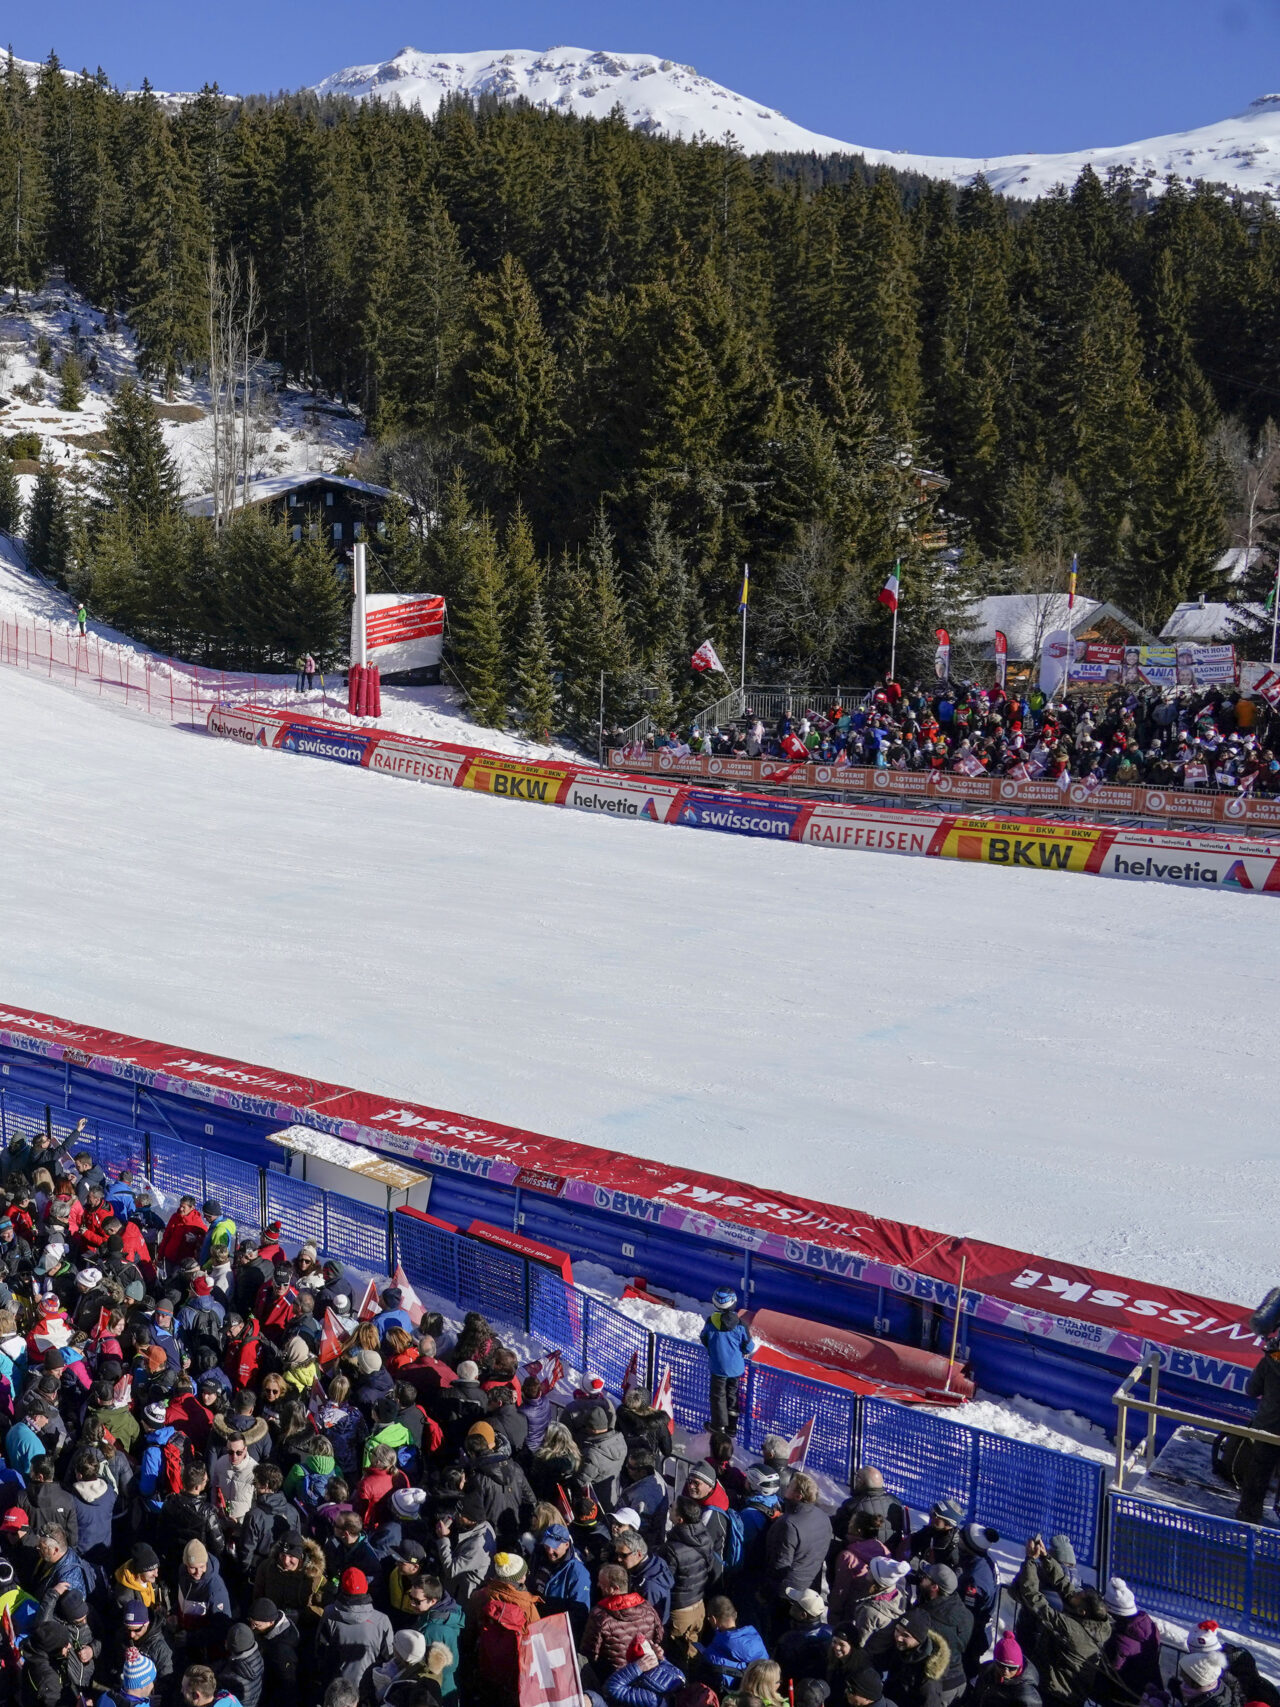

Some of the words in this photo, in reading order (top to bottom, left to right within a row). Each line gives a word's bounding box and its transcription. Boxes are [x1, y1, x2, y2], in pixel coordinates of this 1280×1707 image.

[1088, 645, 1122, 655] MICHELLE
[1080, 664, 1103, 672] ILKA
[1147, 667, 1174, 678] ANIA
[1194, 666, 1232, 674] RAGNHILD
[211, 720, 254, 741] helvetia
[298, 739, 362, 761] swisscom
[373, 753, 454, 782] RAIFFEISEN
[836, 771, 865, 779] LOTERIE
[895, 775, 927, 784] LOTERIE
[830, 777, 865, 785] ROMANDE
[889, 782, 926, 790] ROMANDE
[958, 780, 991, 788] LOTERIE
[493, 774, 549, 801] BKW
[951, 787, 991, 796] ROMANDE
[1017, 792, 1060, 800] ROMANDE
[1095, 790, 1132, 799] LOTERIE
[574, 790, 638, 815] helvetia
[1087, 797, 1132, 806] ROMANDE
[1174, 798, 1212, 806] LOTERIE
[1165, 804, 1212, 814] ROMANDE
[1256, 805, 1280, 813] LOTE
[1246, 812, 1280, 821] ROMAN
[701, 809, 790, 835] swisscom
[969, 821, 988, 829] BKW
[1001, 823, 1021, 831] BKW
[1035, 826, 1056, 835] BKW
[1071, 829, 1092, 838] BKW
[810, 823, 924, 852] RAIFFEISEN
[988, 838, 1073, 869] BKW
[1114, 854, 1218, 883] helvetia
[123, 1064, 157, 1087] BWT
[241, 1099, 278, 1119] BWT
[445, 1150, 493, 1178] BWT
[612, 1192, 665, 1224] BWT
[479, 1230, 492, 1239] Cup
[724, 1229, 754, 1243] WORLD
[492, 1235, 512, 1246] World
[805, 1244, 868, 1280] BWT
[912, 1273, 984, 1315] BWT
[1056, 1317, 1103, 1336] CHANGE
[1064, 1326, 1102, 1343] WORLD
[1170, 1348, 1253, 1392] BWT
